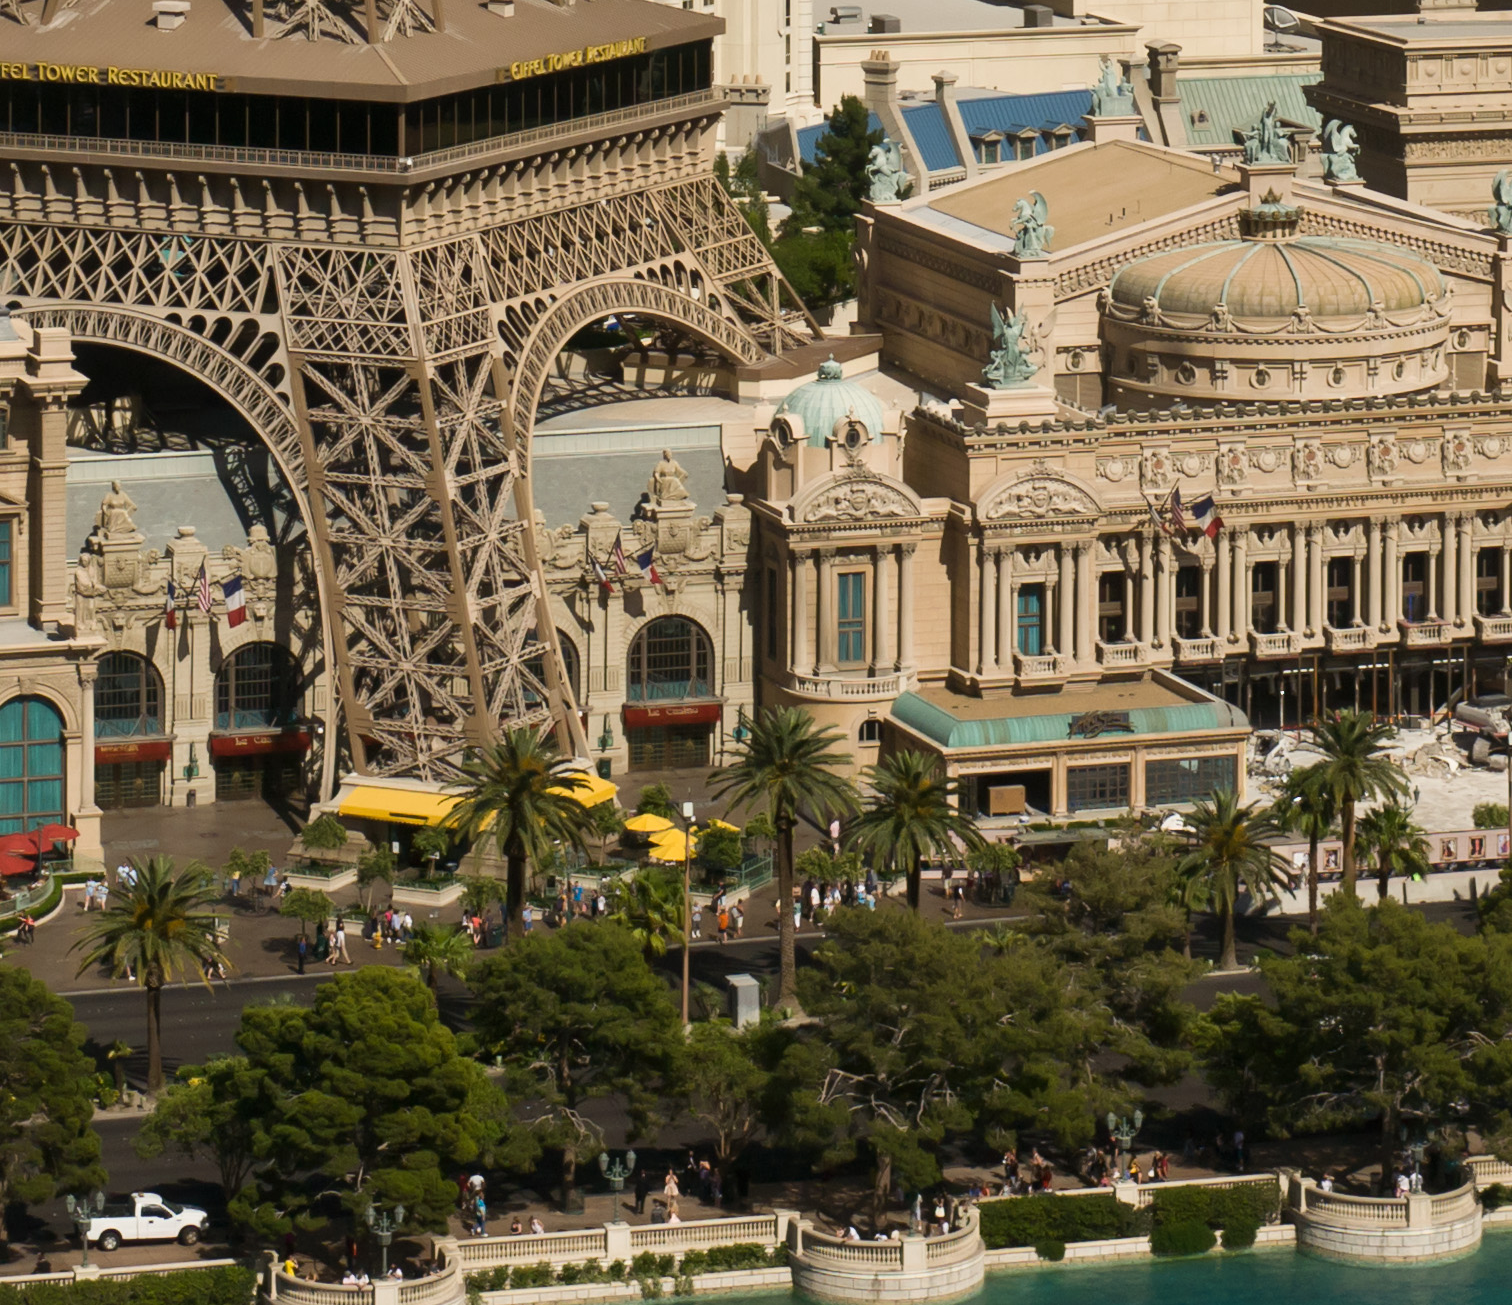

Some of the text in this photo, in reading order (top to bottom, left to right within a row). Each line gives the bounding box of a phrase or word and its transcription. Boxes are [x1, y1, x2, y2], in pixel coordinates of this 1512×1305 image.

[511, 37, 647, 81] EIFFEL TOWER RESTAURANT
[37, 61, 99, 83] TOWER
[107, 66, 218, 91] RESTAURANT
[1218, 505, 1271, 516] CADEMIE
[1297, 499, 1367, 510] NATIONALE
[1392, 496, 1406, 504] DE
